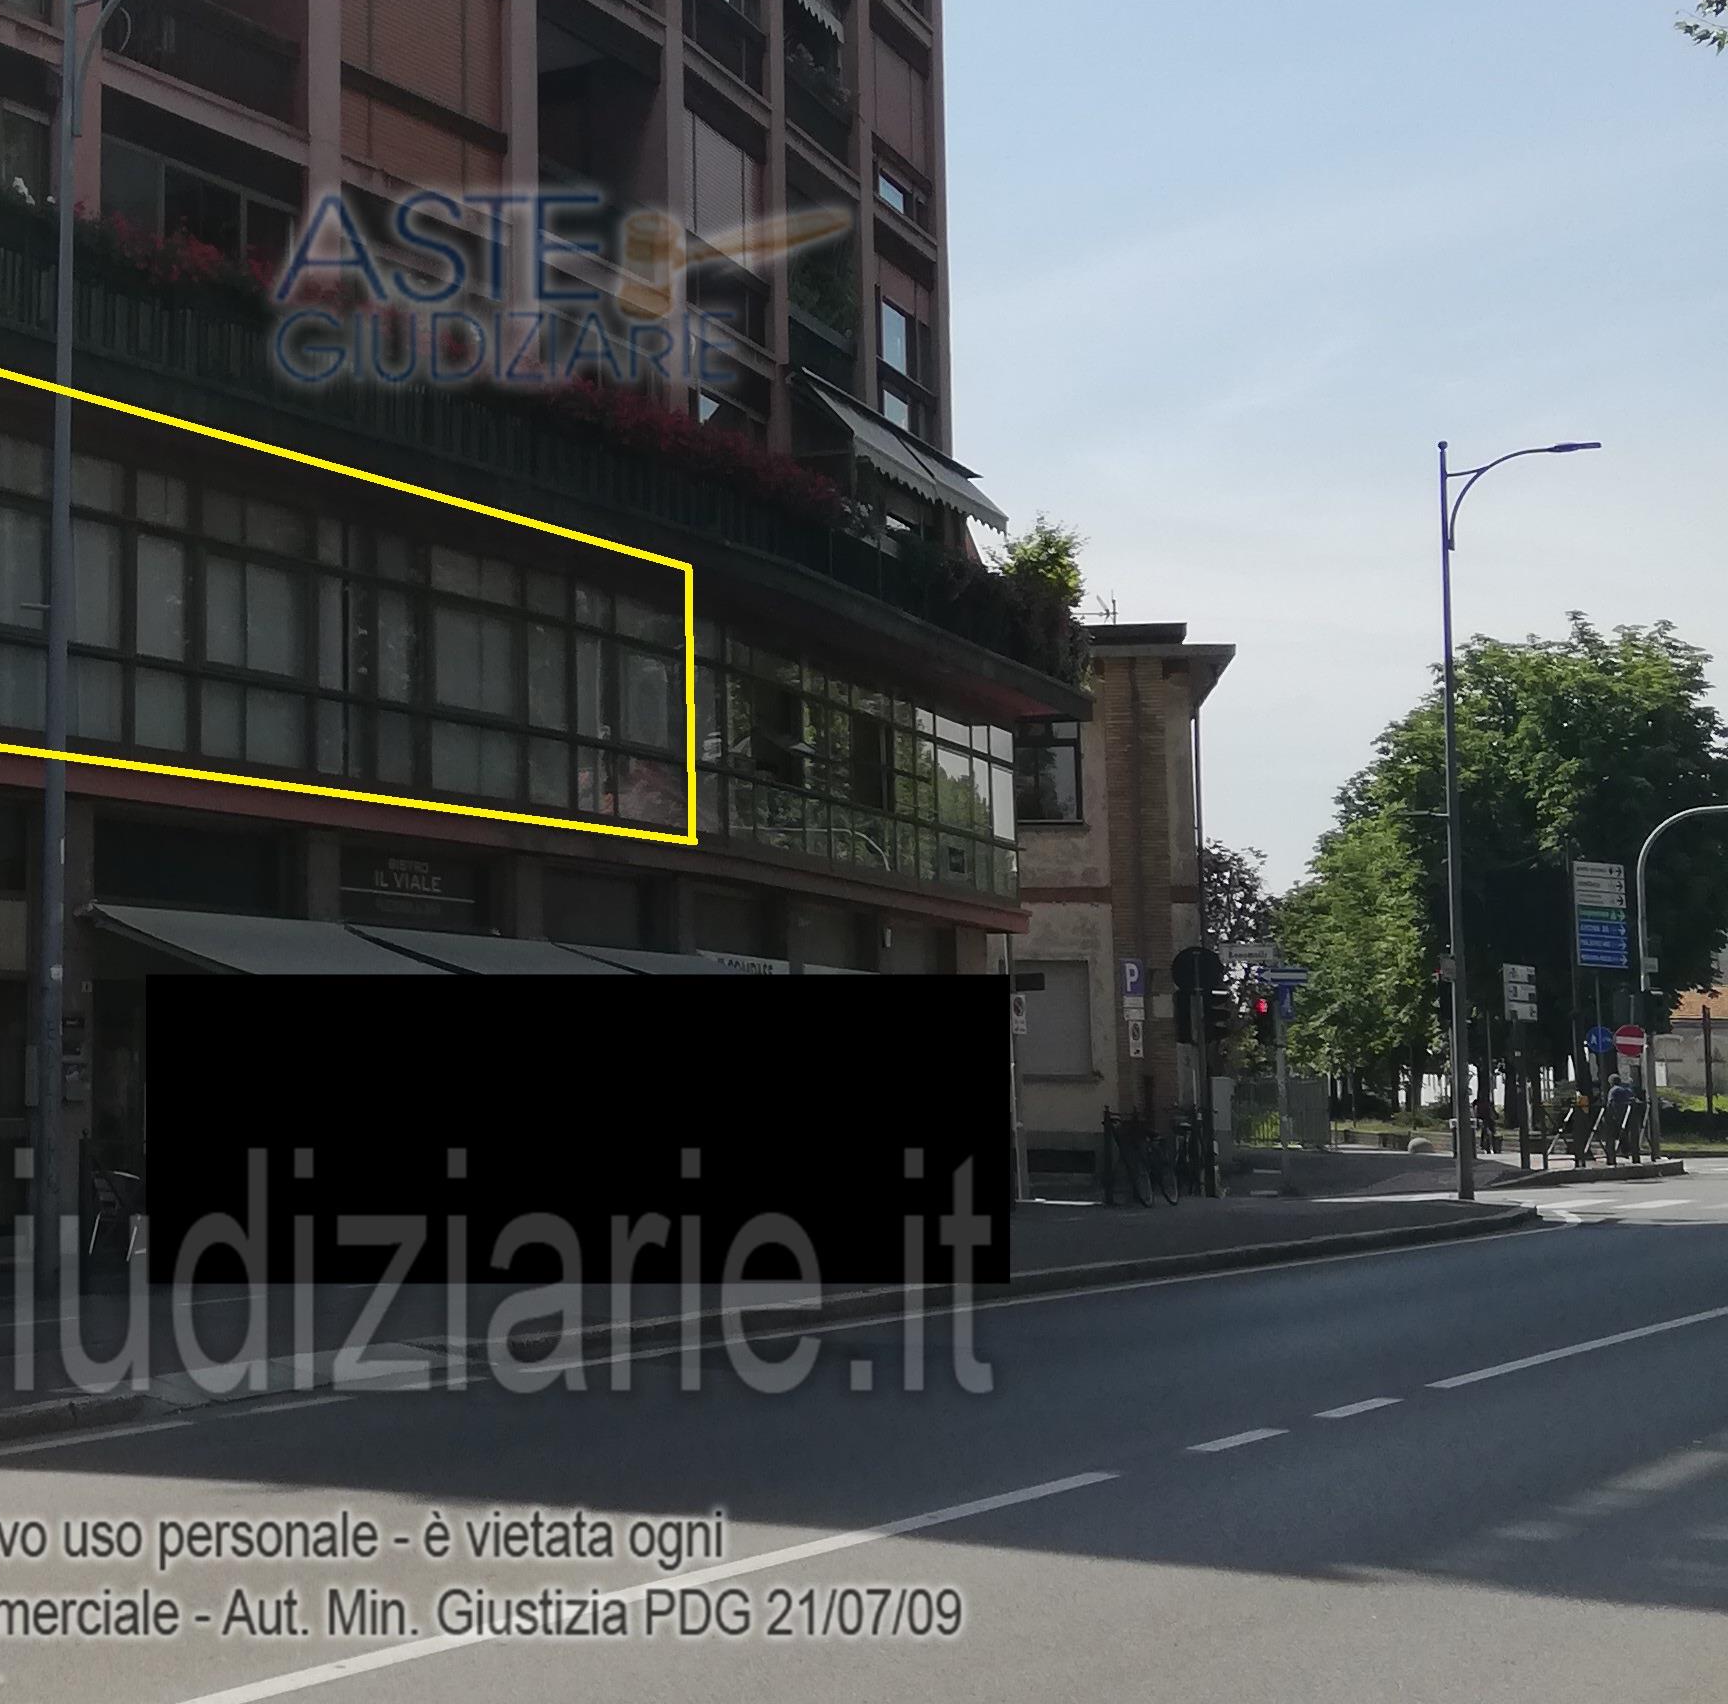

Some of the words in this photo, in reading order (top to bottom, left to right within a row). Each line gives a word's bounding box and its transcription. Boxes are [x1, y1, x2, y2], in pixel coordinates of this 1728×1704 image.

[374, 869, 388, 887] IL
[393, 871, 443, 893] VIALE
[1124, 962, 1139, 992] P
